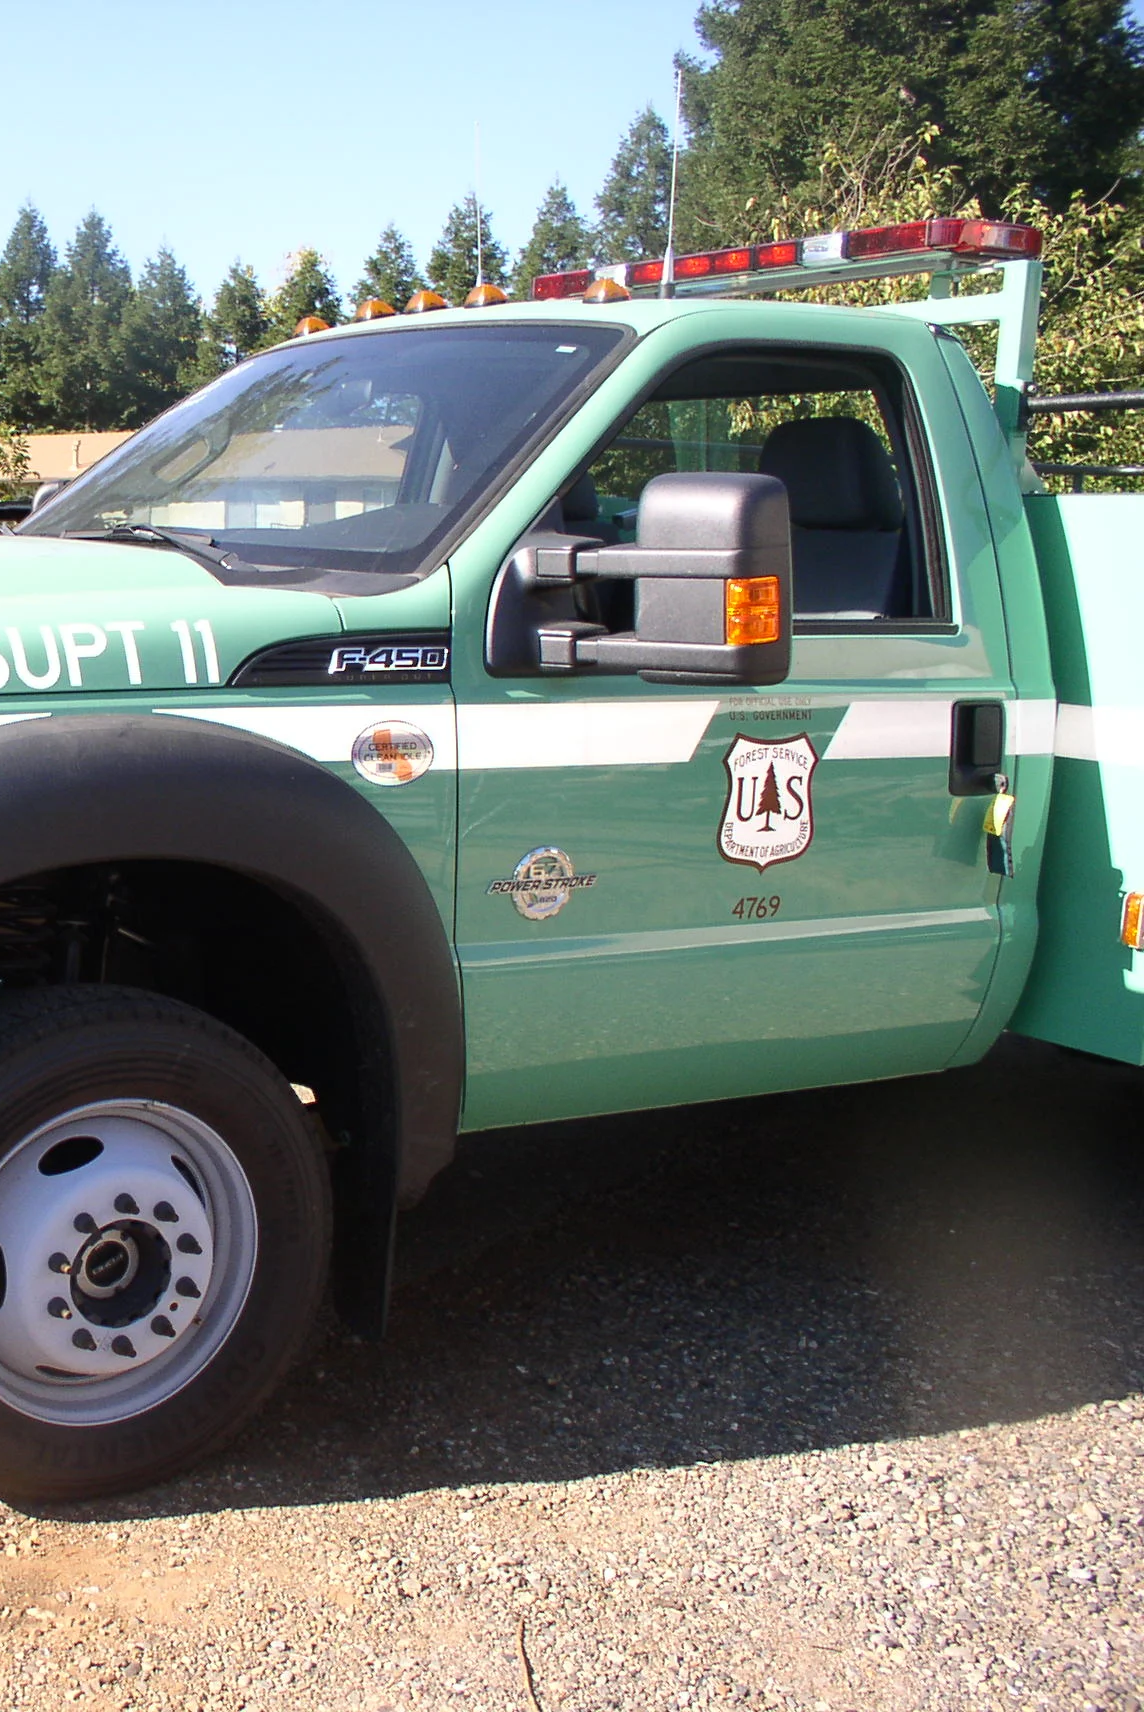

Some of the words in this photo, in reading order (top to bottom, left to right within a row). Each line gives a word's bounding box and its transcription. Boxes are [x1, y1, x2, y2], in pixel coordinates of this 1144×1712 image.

[169, 619, 220, 685] 11
[328, 648, 448, 675] F-450
[729, 710, 749, 721] U.S.
[753, 710, 813, 721] GOVERNMENT
[368, 741, 417, 751] CERTIFIED
[734, 747, 769, 771] FOREST
[772, 747, 808, 770] SERVICE
[724, 822, 760, 858] DEPARTMENT
[760, 846, 770, 858] OF
[770, 820, 809, 857] AGRICULTURE
[491, 880, 540, 893] POWER
[542, 875, 597, 890] STROKE
[732, 895, 781, 919] 4769
